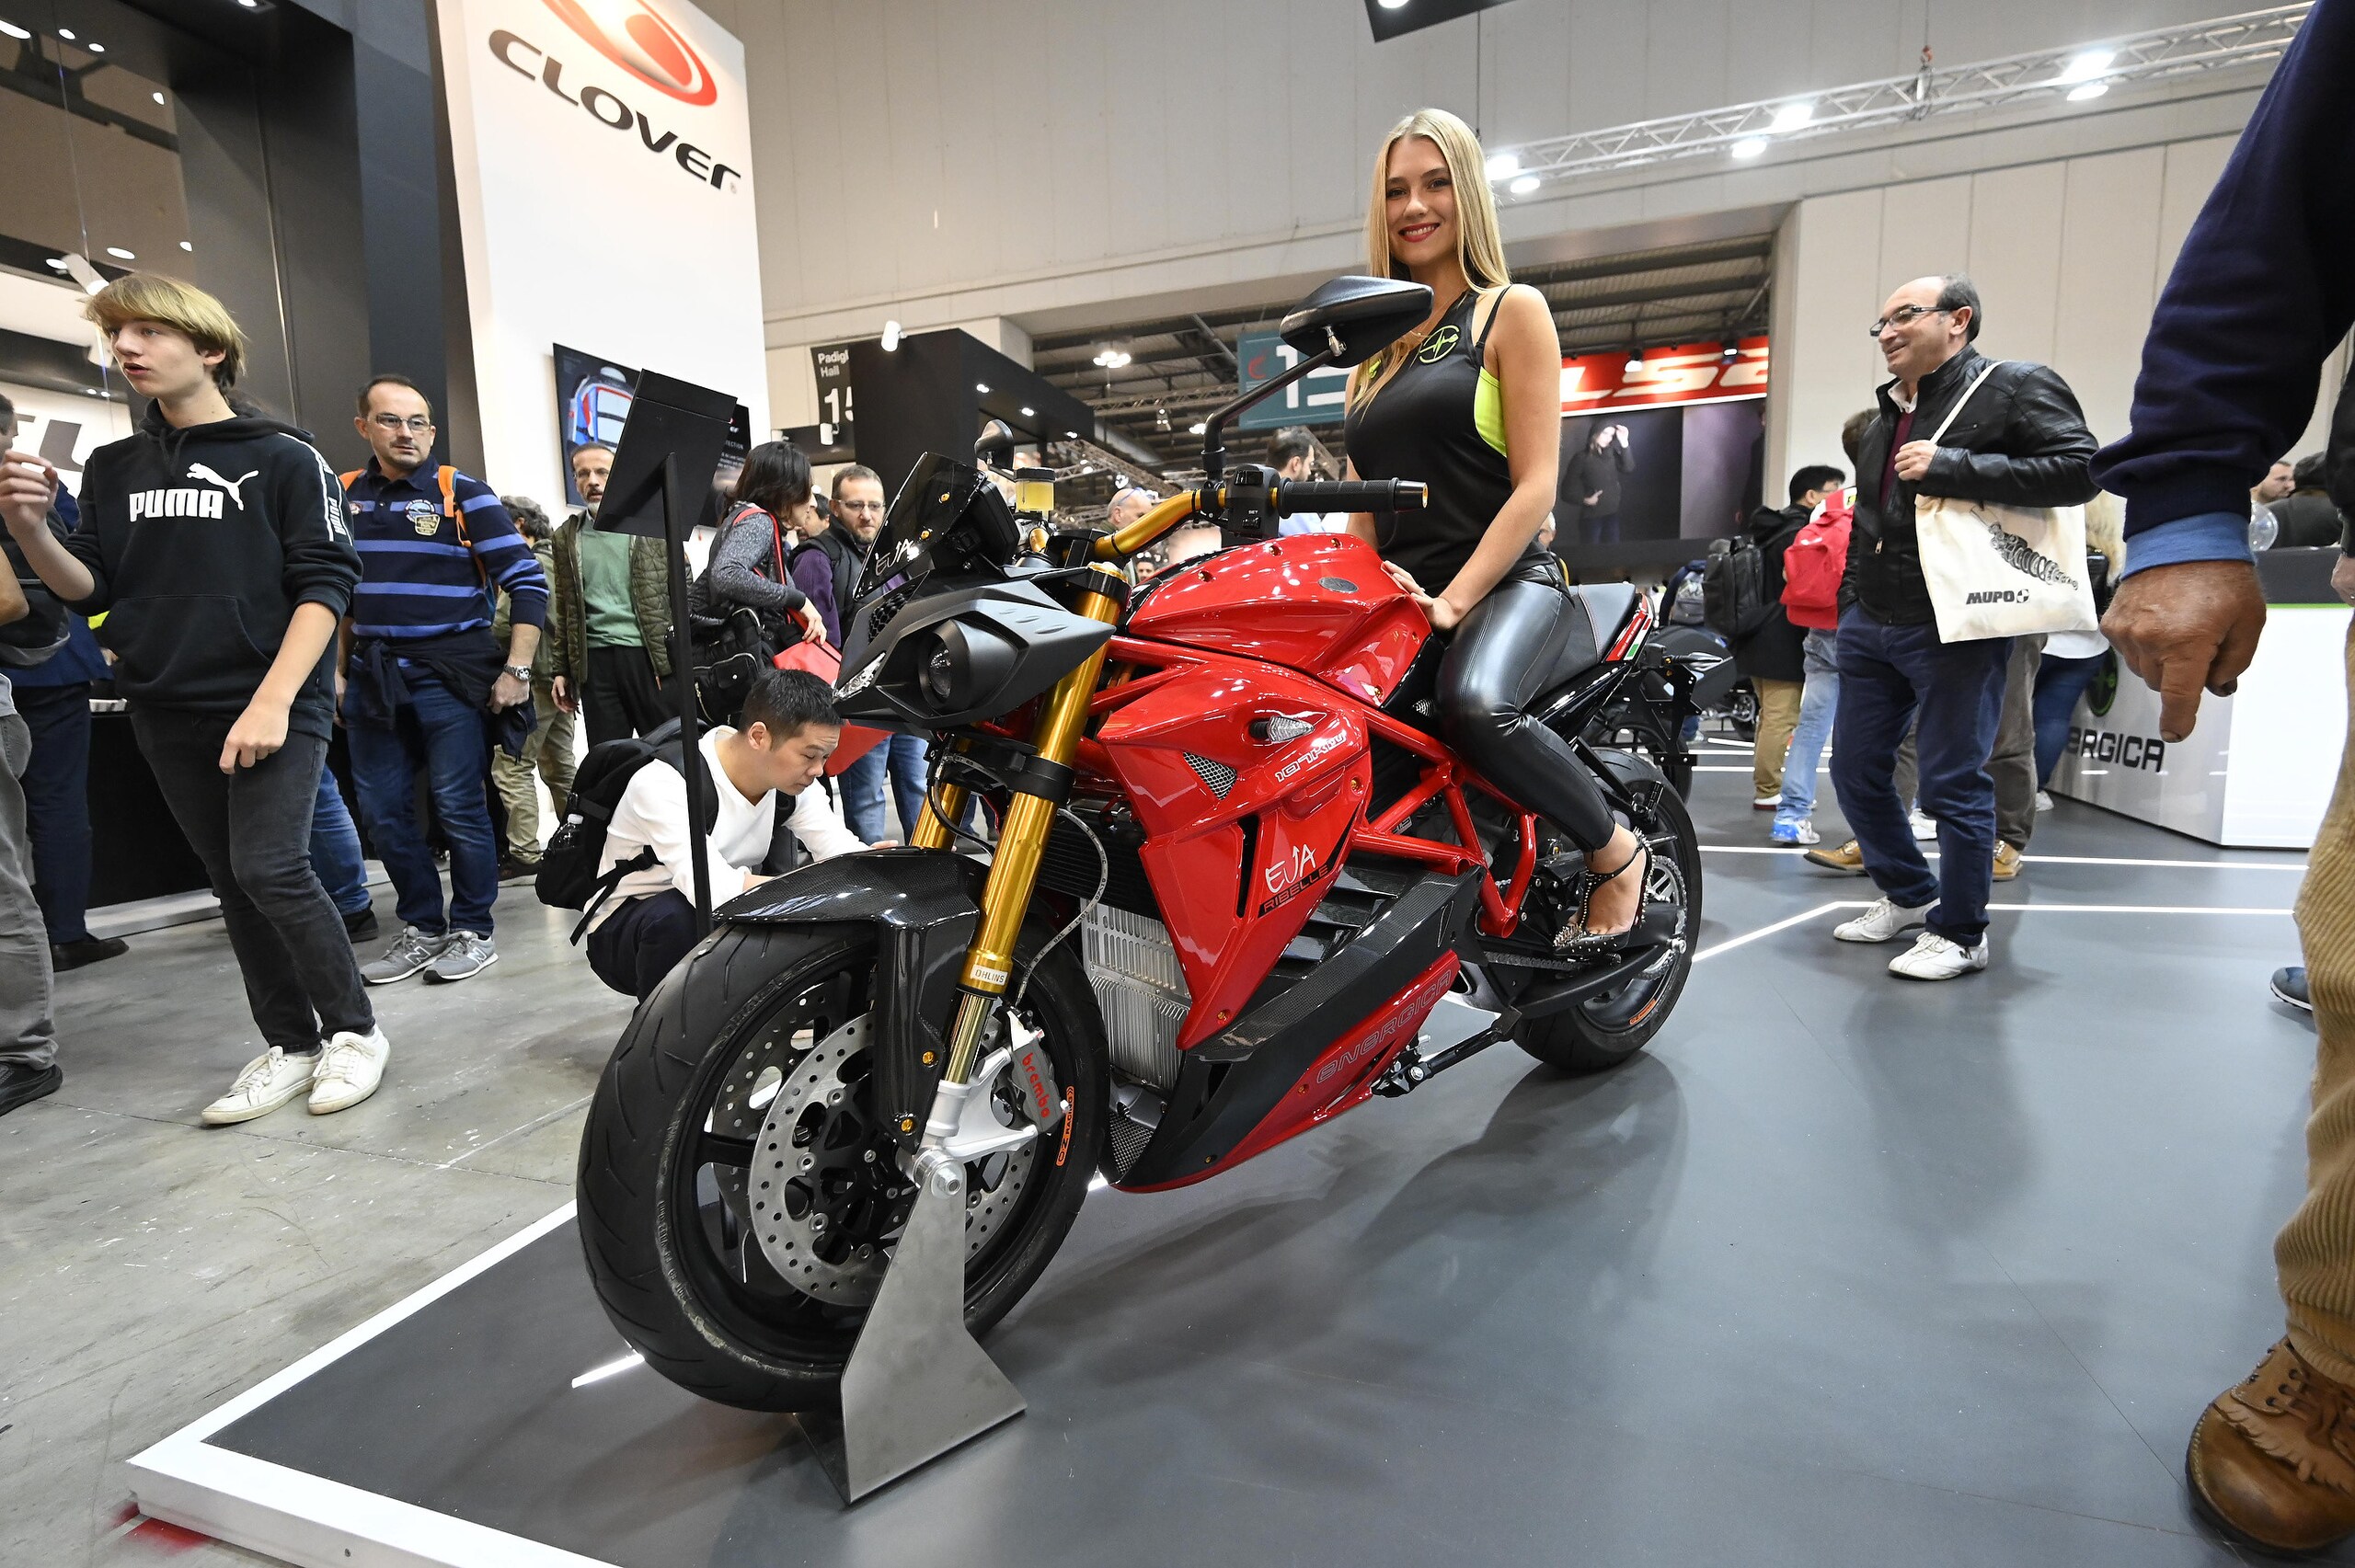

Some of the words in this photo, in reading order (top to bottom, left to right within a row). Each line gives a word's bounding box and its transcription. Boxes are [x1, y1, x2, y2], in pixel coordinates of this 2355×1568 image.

[821, 365, 840, 377] Hall
[1276, 344, 1350, 408] 1
[129, 488, 224, 522] PUMA
[327, 496, 347, 536] PUMA
[1966, 590, 2015, 605] MUPO
[1264, 864, 1328, 913] RIBELLE
[1022, 1052, 1051, 1118] brembo
